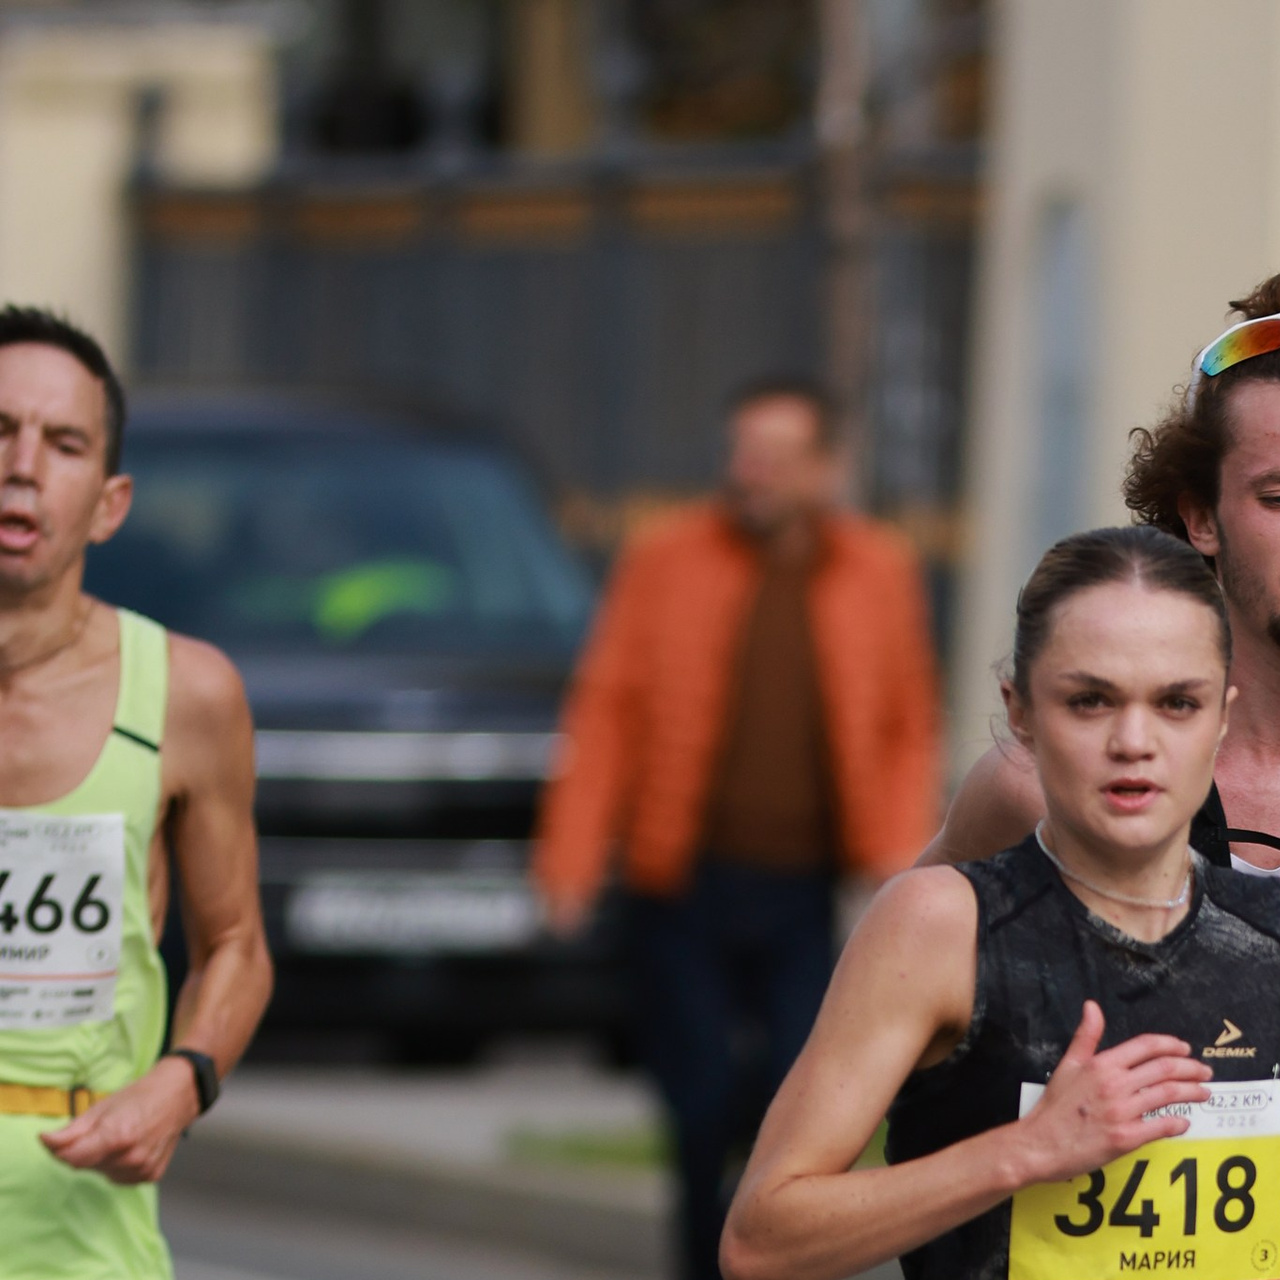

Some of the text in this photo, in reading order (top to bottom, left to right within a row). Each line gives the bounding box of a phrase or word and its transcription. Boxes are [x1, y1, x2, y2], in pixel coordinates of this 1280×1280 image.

[1202, 1046, 1256, 1058] DEMIX
[1054, 1154, 1257, 1238] 3418
[1119, 1250, 1196, 1271] МАРИЯ
